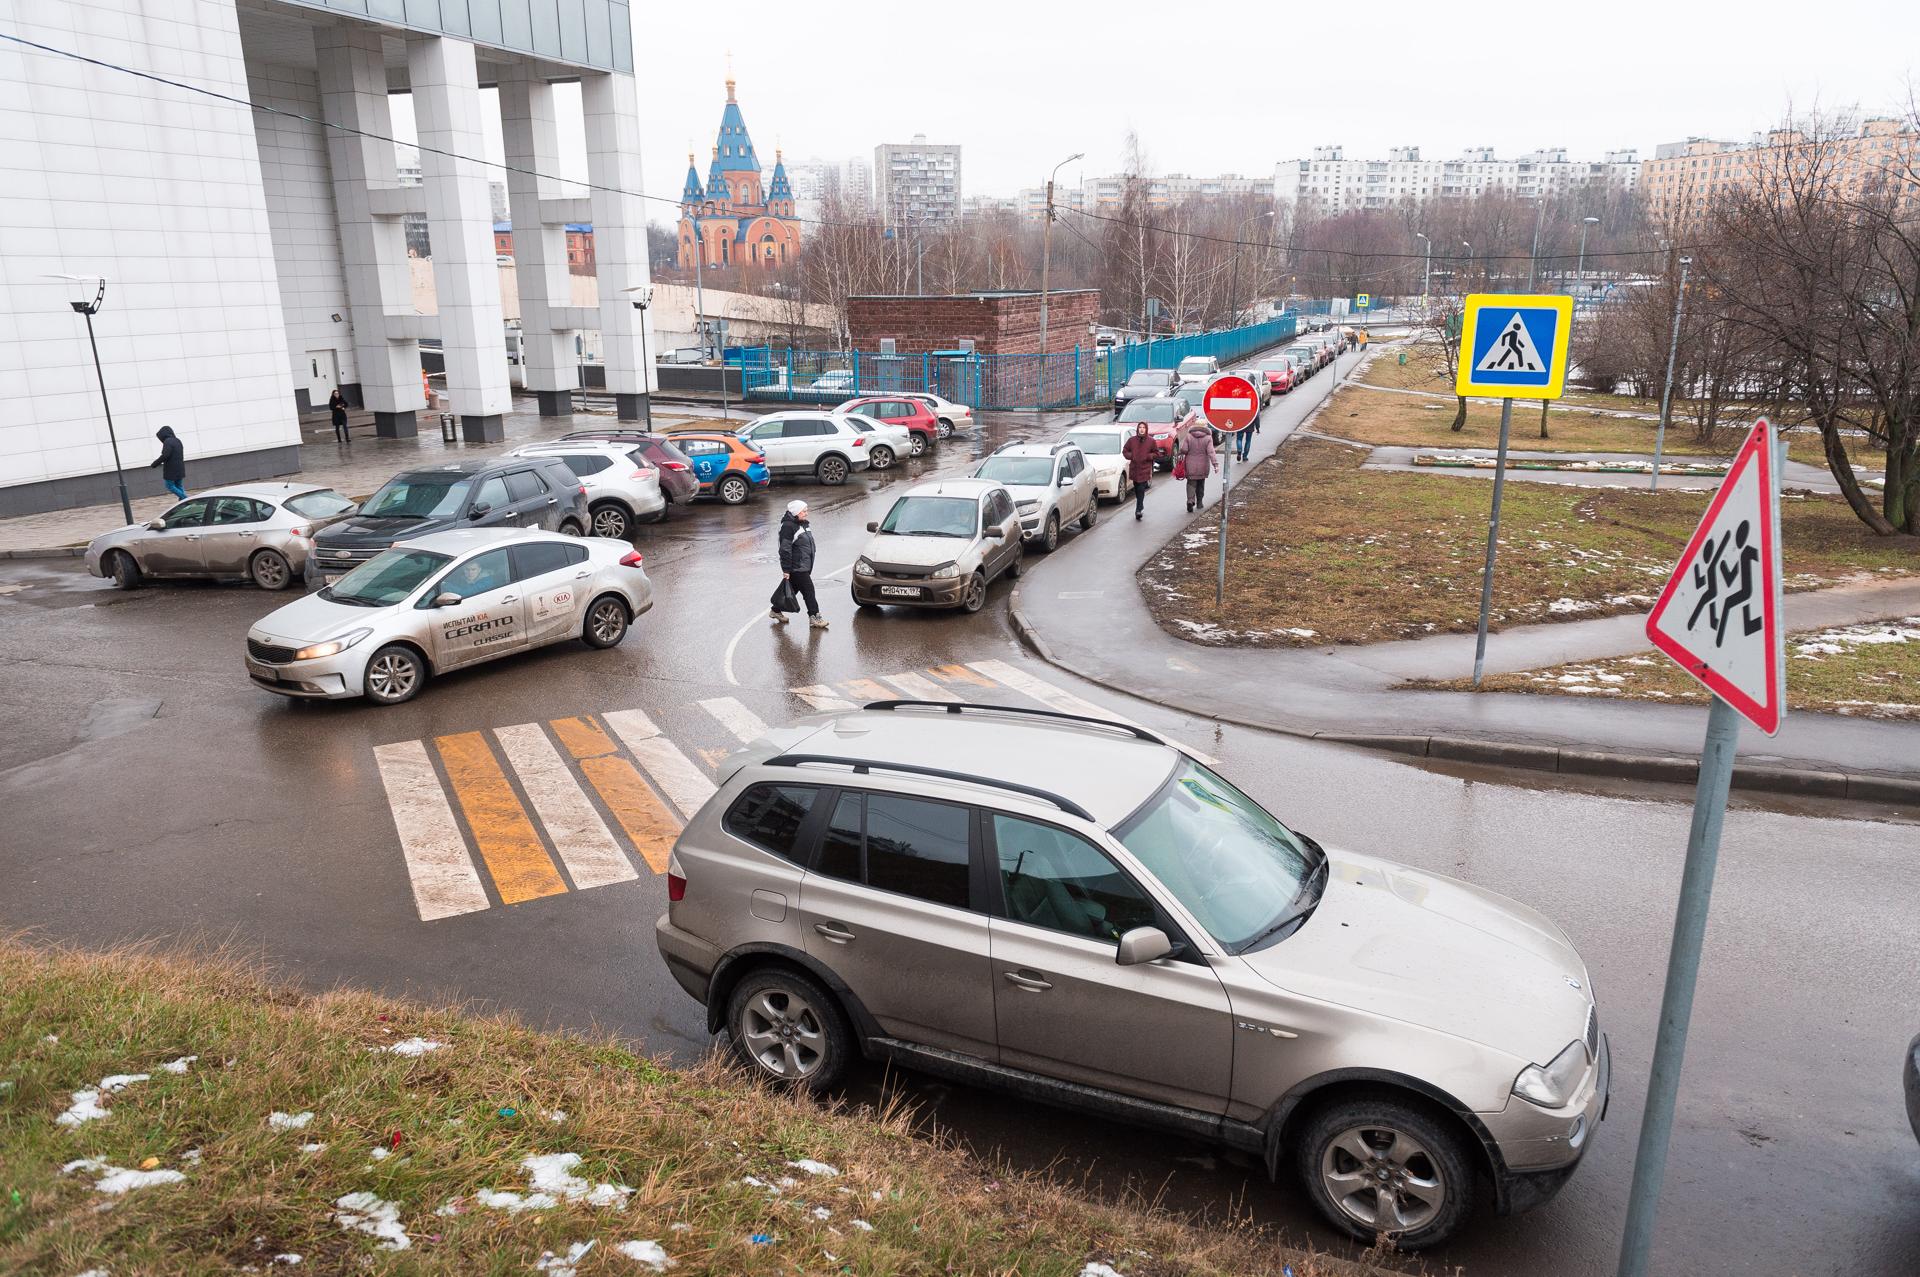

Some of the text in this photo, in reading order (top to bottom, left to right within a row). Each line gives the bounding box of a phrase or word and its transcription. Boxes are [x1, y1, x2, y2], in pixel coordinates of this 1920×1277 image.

[556, 594, 569, 603] KIA
[443, 612, 488, 629] ИСПЫТАЙ KIA
[445, 615, 513, 640] CERATO
[473, 631, 513, 647] CLASSIC
